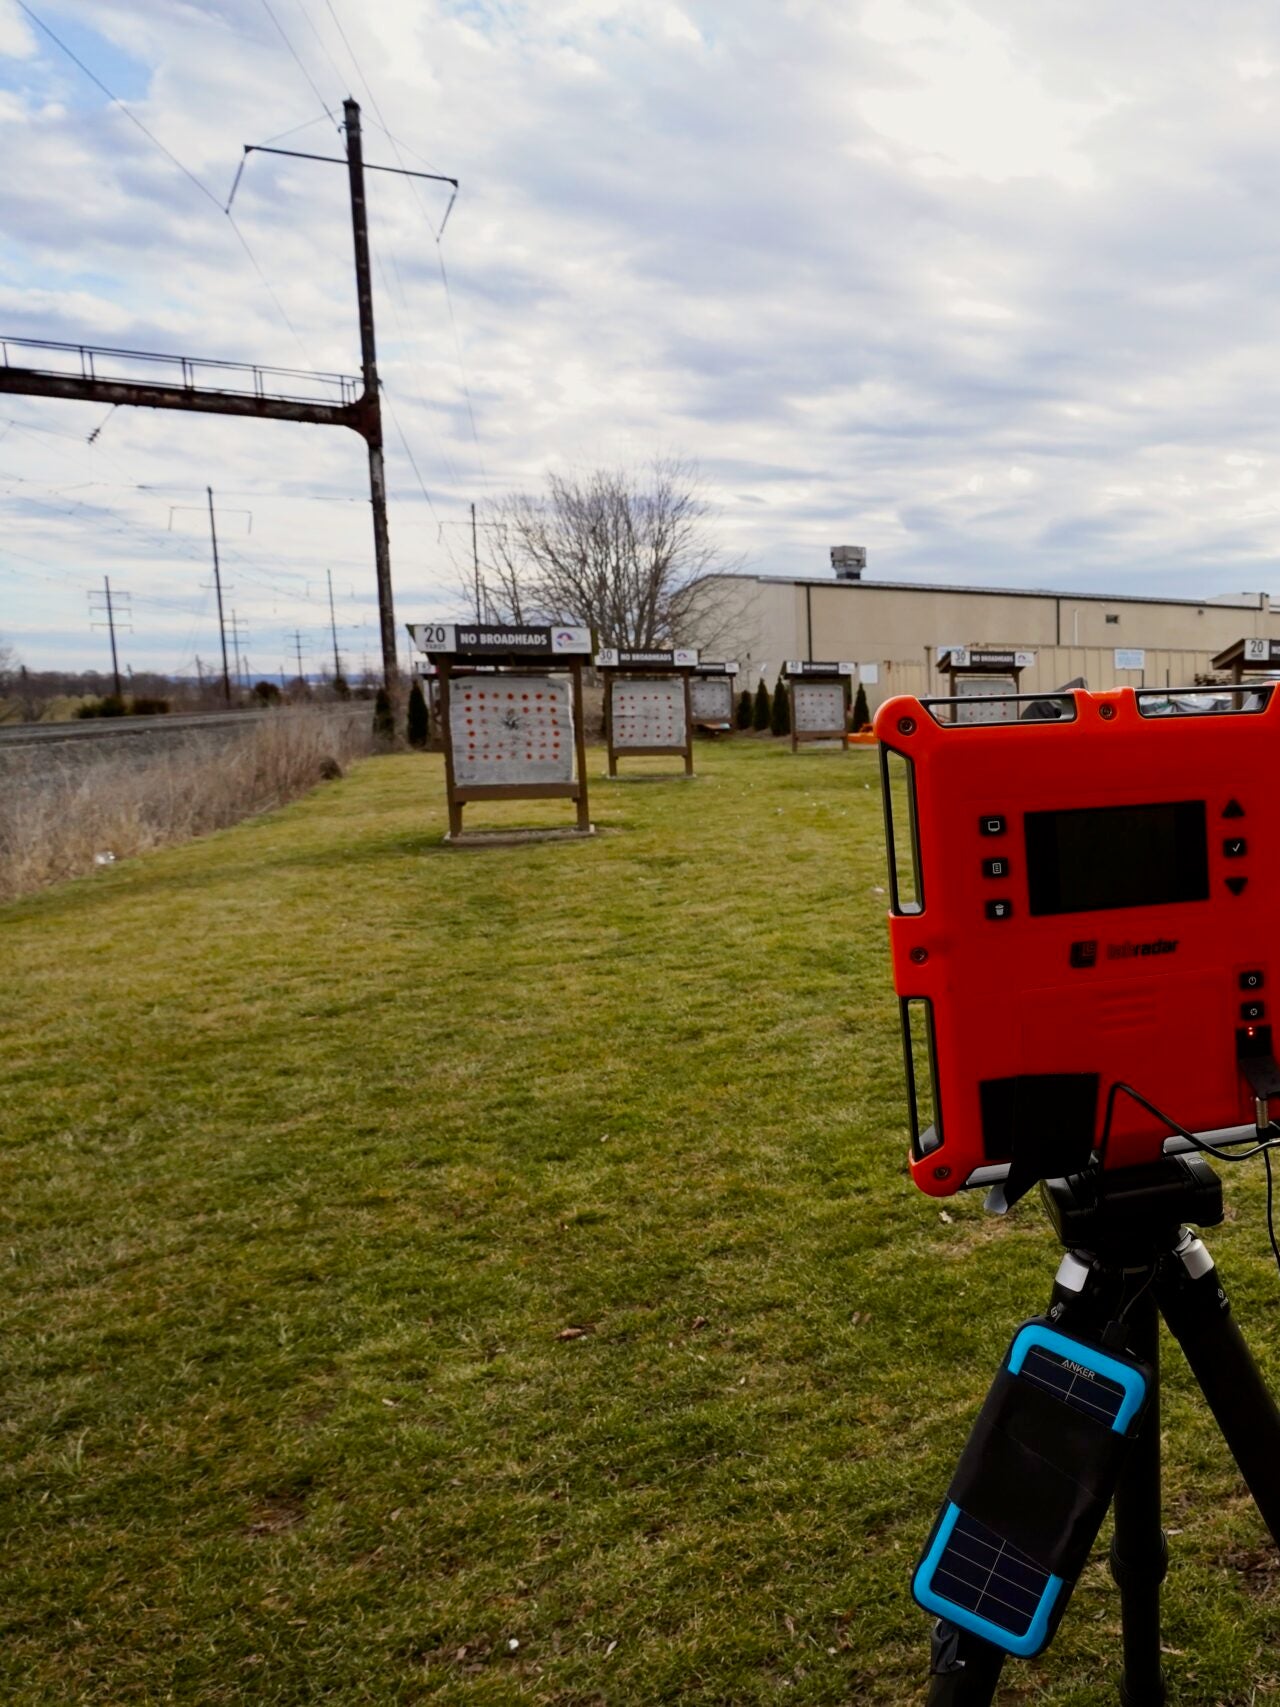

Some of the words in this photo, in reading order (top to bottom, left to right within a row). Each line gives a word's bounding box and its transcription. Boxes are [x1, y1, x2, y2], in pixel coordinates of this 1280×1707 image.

[423, 626, 446, 643] 20
[460, 633, 477, 645] NO
[480, 633, 547, 646] BROADHEADS
[1250, 640, 1264, 653] 20
[599, 649, 613, 660] 30
[1061, 1359, 1096, 1380] ANKER
